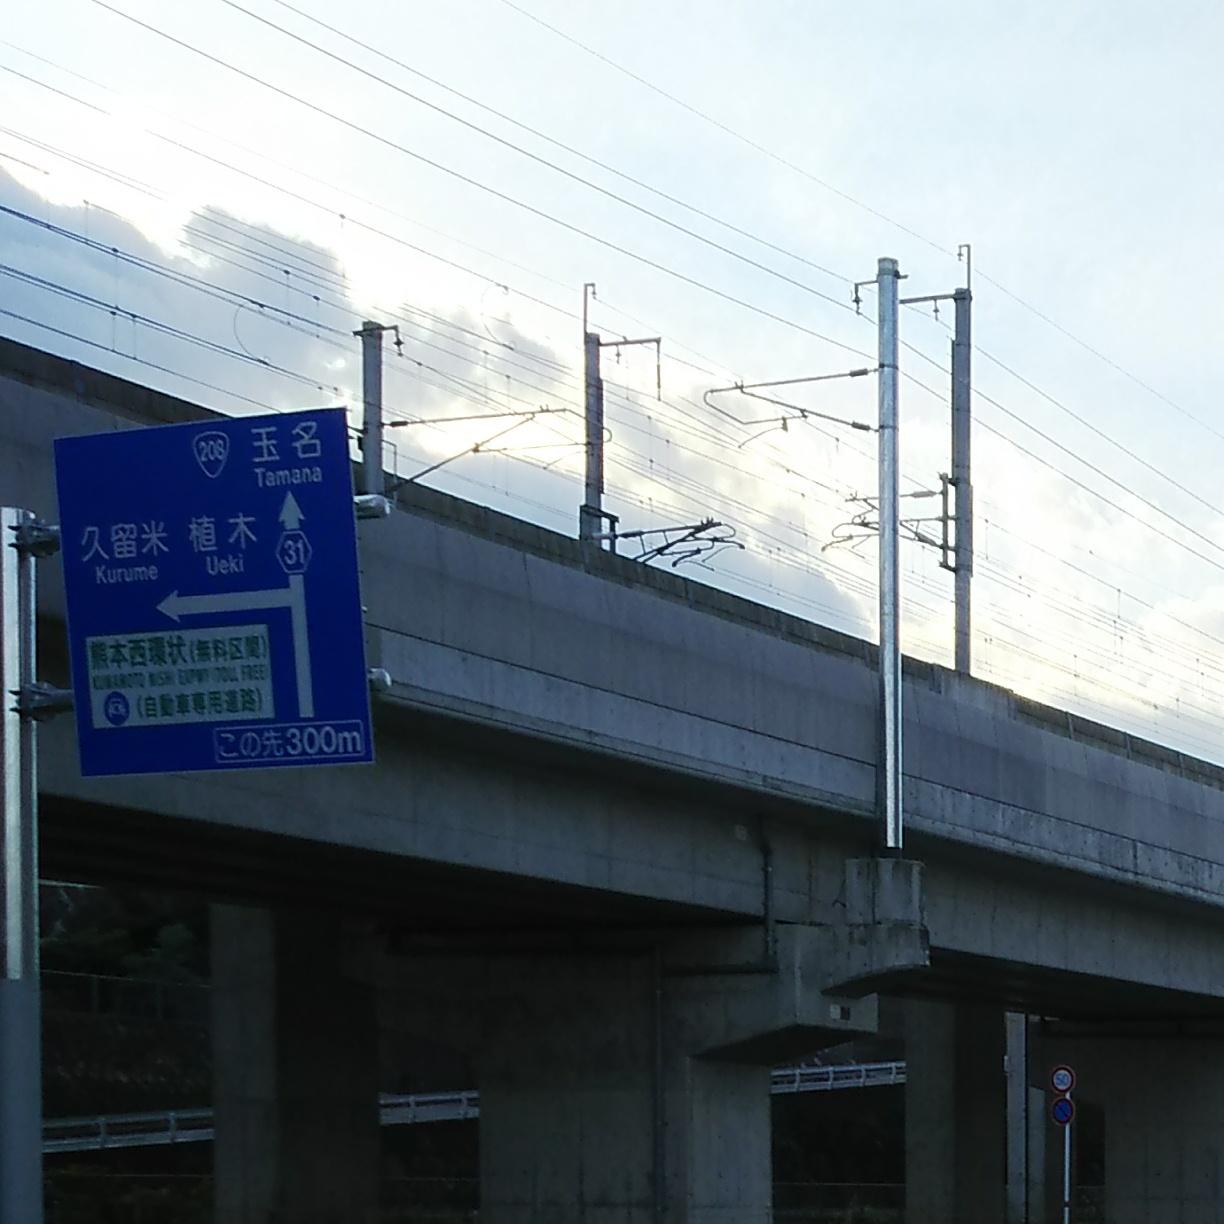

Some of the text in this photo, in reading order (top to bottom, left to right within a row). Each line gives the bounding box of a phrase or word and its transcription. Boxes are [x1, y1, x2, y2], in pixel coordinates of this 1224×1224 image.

[200, 440, 225, 463] 208
[251, 421, 322, 463] 玉名
[254, 465, 323, 488] Tamana
[81, 512, 258, 562] 久留米 植木
[283, 539, 307, 566] 31
[95, 553, 245, 585] Kurume Ueki
[219, 726, 363, 758] この先300m
